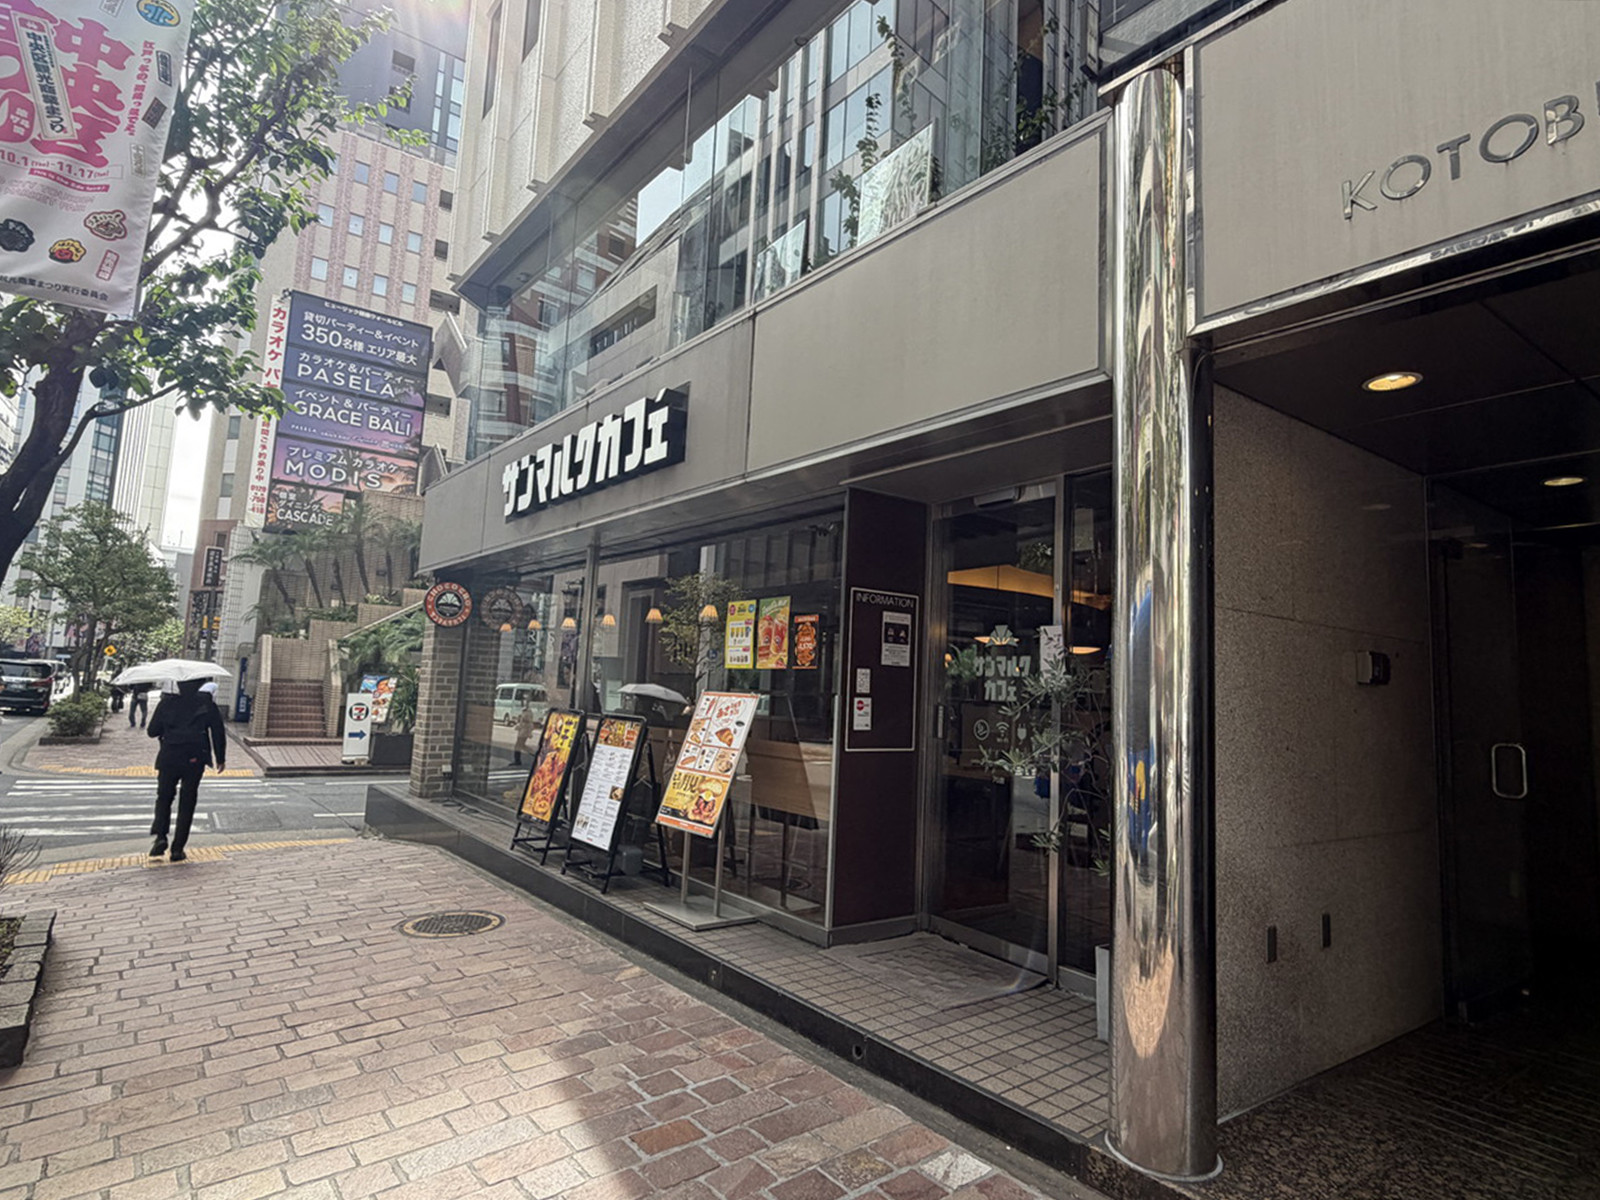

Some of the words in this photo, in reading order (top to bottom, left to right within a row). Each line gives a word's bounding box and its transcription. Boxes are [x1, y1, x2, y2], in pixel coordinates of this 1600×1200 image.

[267, 306, 288, 362] カラオケ
[301, 323, 365, 353] 350名様
[366, 344, 418, 366] エリア最大
[297, 364, 395, 398] PASELA
[293, 401, 362, 427] GRACE
[368, 413, 411, 437] BALI
[288, 446, 349, 466] プレミアム
[352, 457, 399, 474] カラオケ
[502, 388, 669, 516] サンマルクカフェ
[285, 460, 382, 489] MODIS
[276, 508, 334, 527] CASCADE
[855, 592, 915, 608] INFORMATION
[973, 655, 1032, 677] サンマルク
[984, 680, 1017, 702] カフェ
